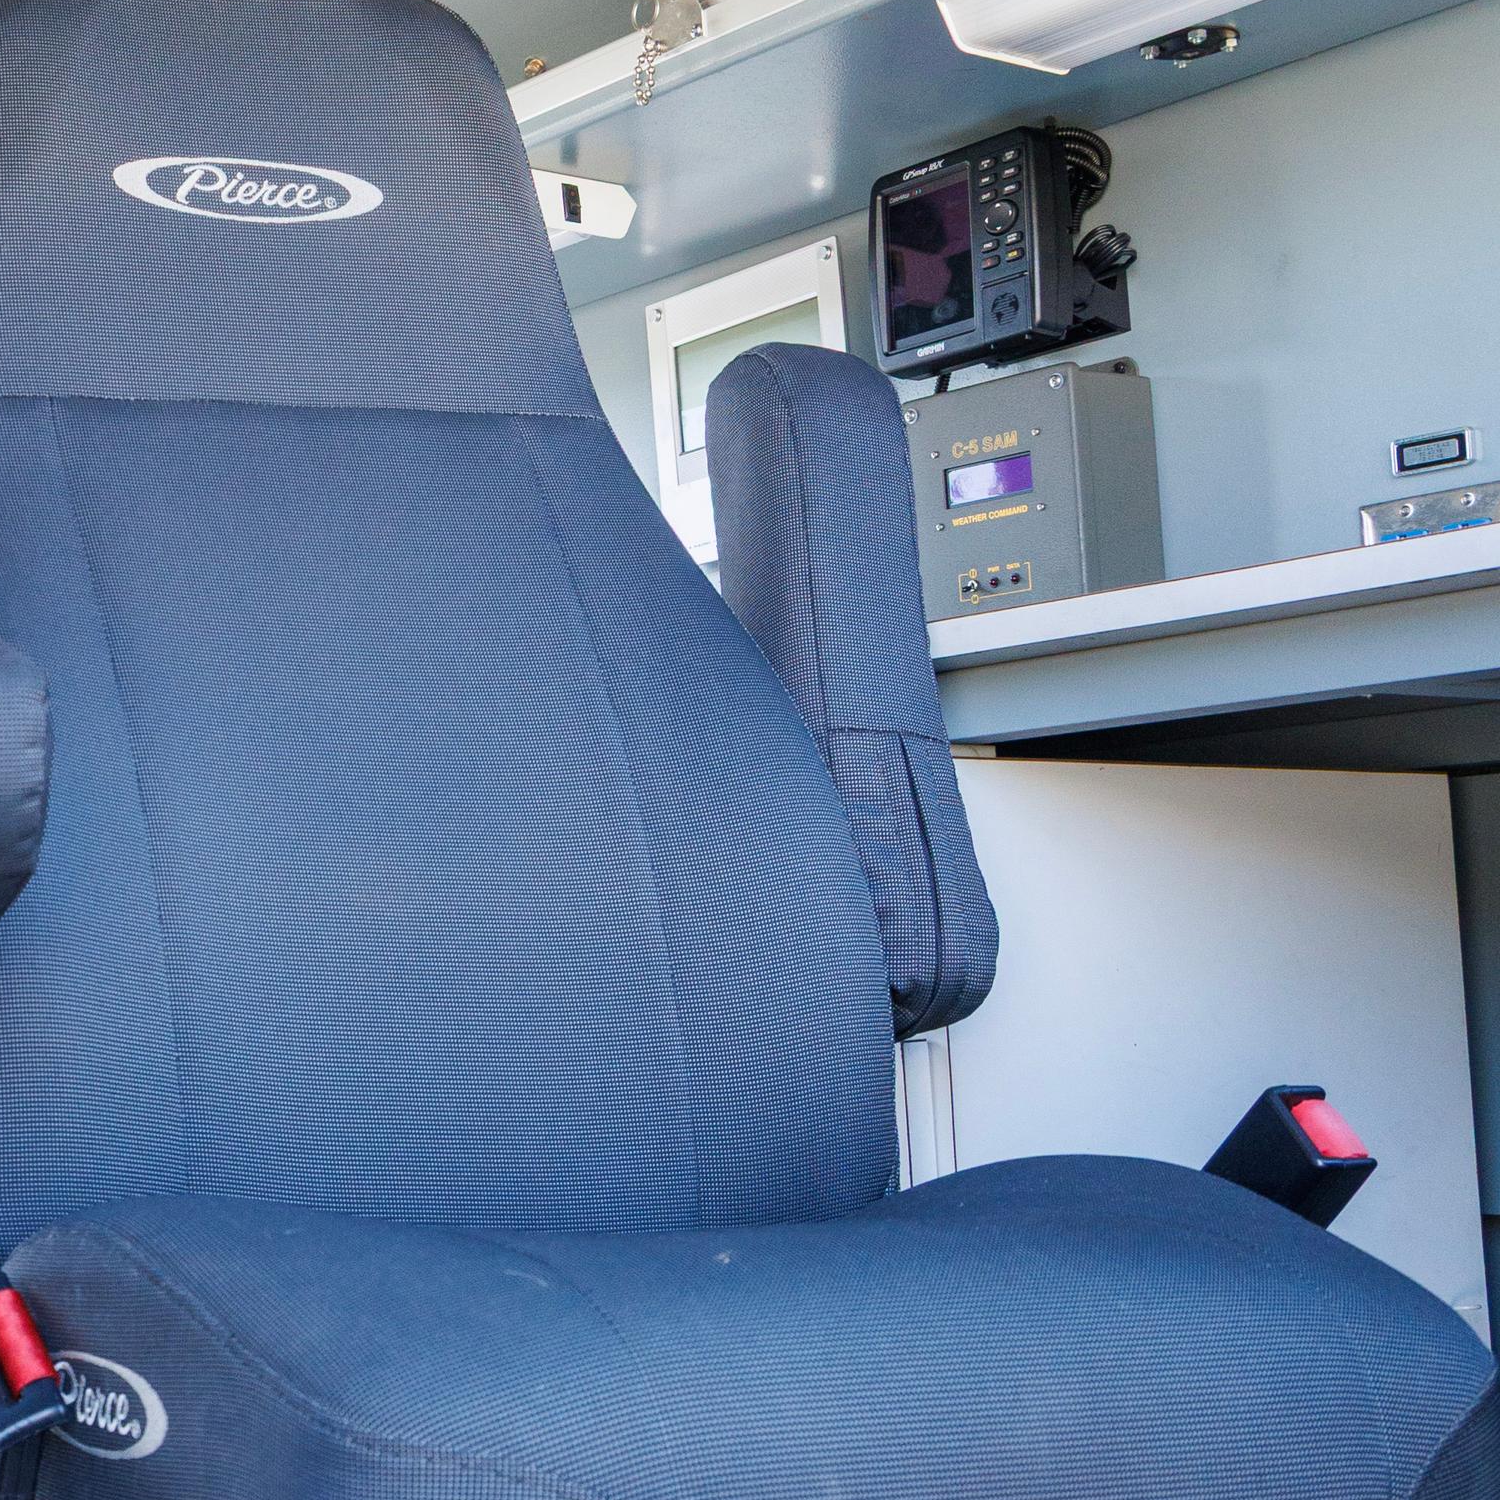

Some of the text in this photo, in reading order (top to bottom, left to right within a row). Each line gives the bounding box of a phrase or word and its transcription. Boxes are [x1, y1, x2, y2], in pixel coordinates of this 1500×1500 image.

[176, 164, 322, 209] Pierce
[916, 341, 945, 357] GARMIN
[951, 430, 1018, 458] C-5 SAM
[952, 505, 1028, 527] WEATHER COMMAND
